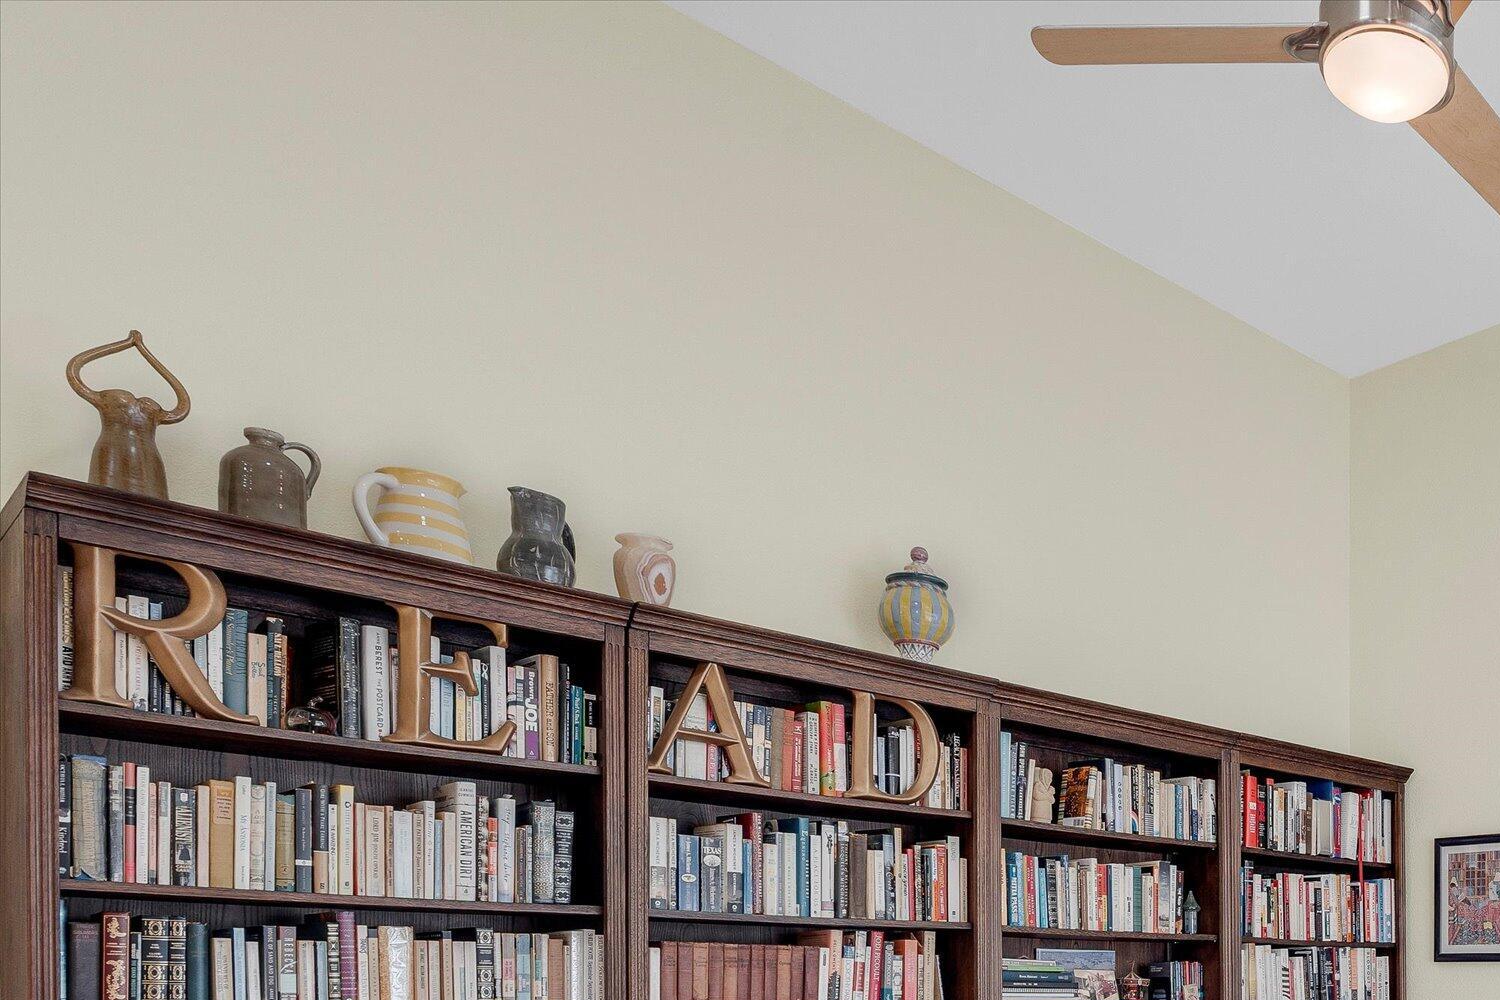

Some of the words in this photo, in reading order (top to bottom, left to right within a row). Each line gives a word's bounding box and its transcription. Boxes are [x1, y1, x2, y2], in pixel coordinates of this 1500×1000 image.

[525, 698, 537, 731] JOE
[545, 682, 553, 717] FATHER
[59, 827, 67, 853] Kindred
[460, 810, 473, 858] AMERICAN
[460, 860, 473, 880] DIRT
[283, 938, 295, 974] REBECCA
